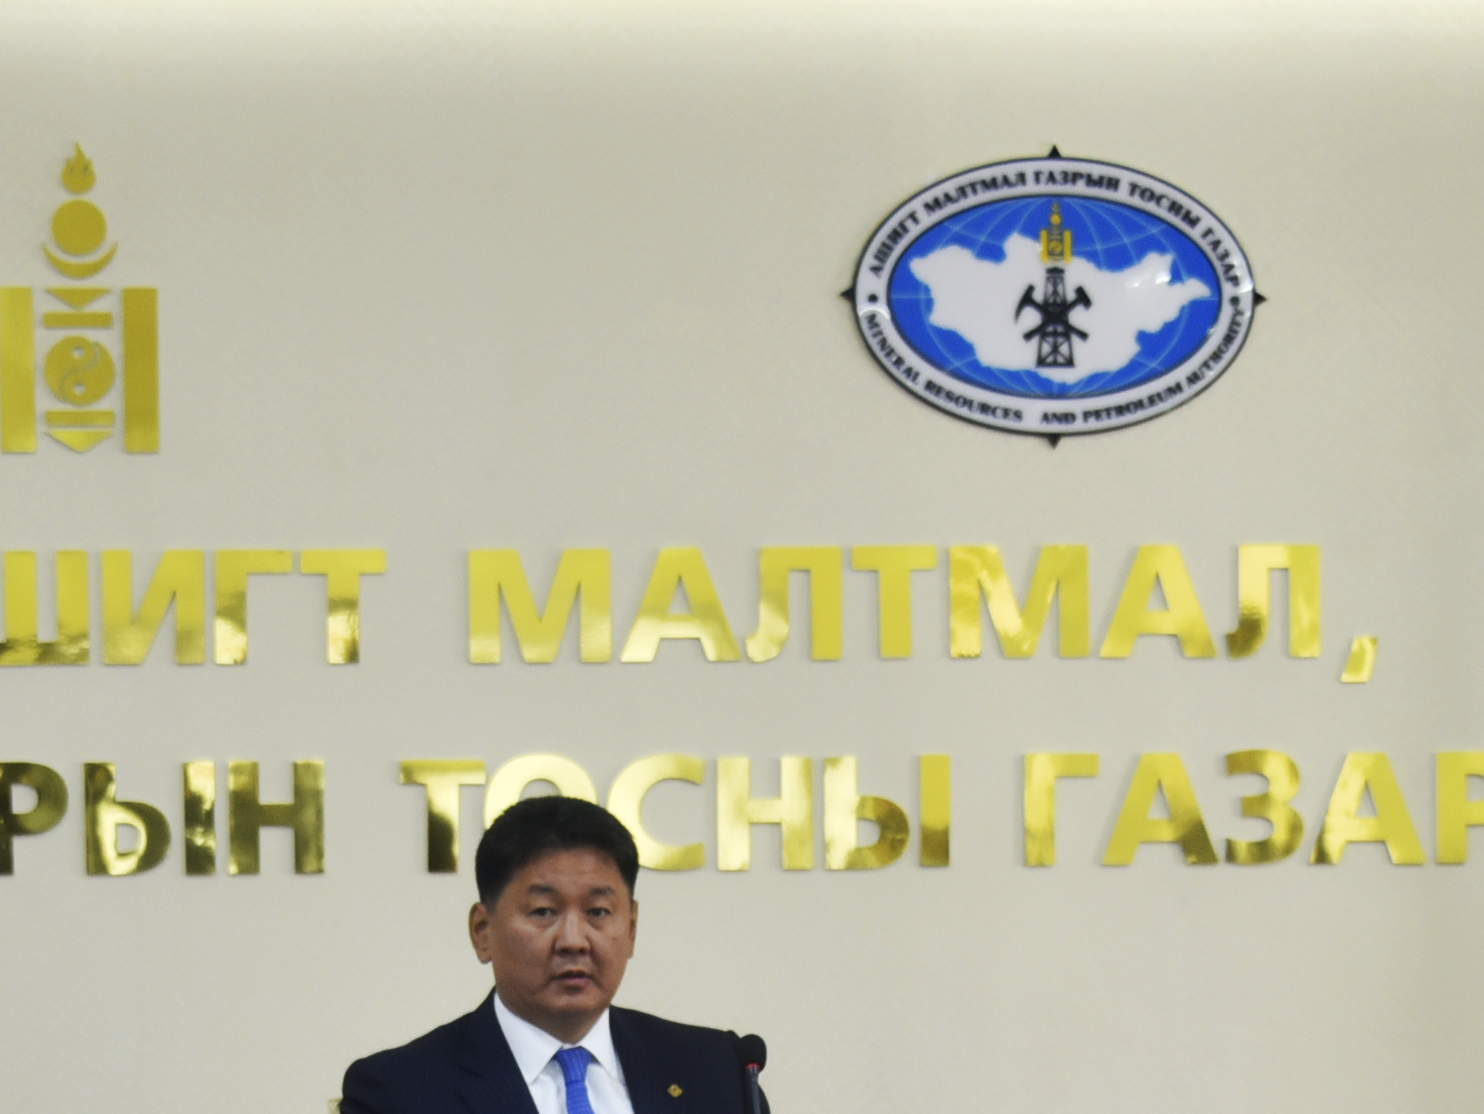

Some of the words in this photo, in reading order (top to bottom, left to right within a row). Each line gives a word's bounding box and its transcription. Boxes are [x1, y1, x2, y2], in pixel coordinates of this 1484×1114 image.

[869, 210, 920, 279] АШИГТ
[923, 171, 1027, 217] МАЛТМАЛ
[1033, 170, 1120, 192] ГАЗРЫН
[1128, 182, 1201, 229] ТОСНЫ
[1201, 227, 1250, 288] ГАЗАР
[866, 312, 921, 387] MINERAL
[924, 378, 1023, 423] RESOURCES
[1040, 411, 1077, 424] AND
[1082, 382, 1183, 423] PETROLEUM
[1186, 308, 1245, 386] AUTHORITY
[466, 543, 1380, 684] МАЛТМАЛ,
